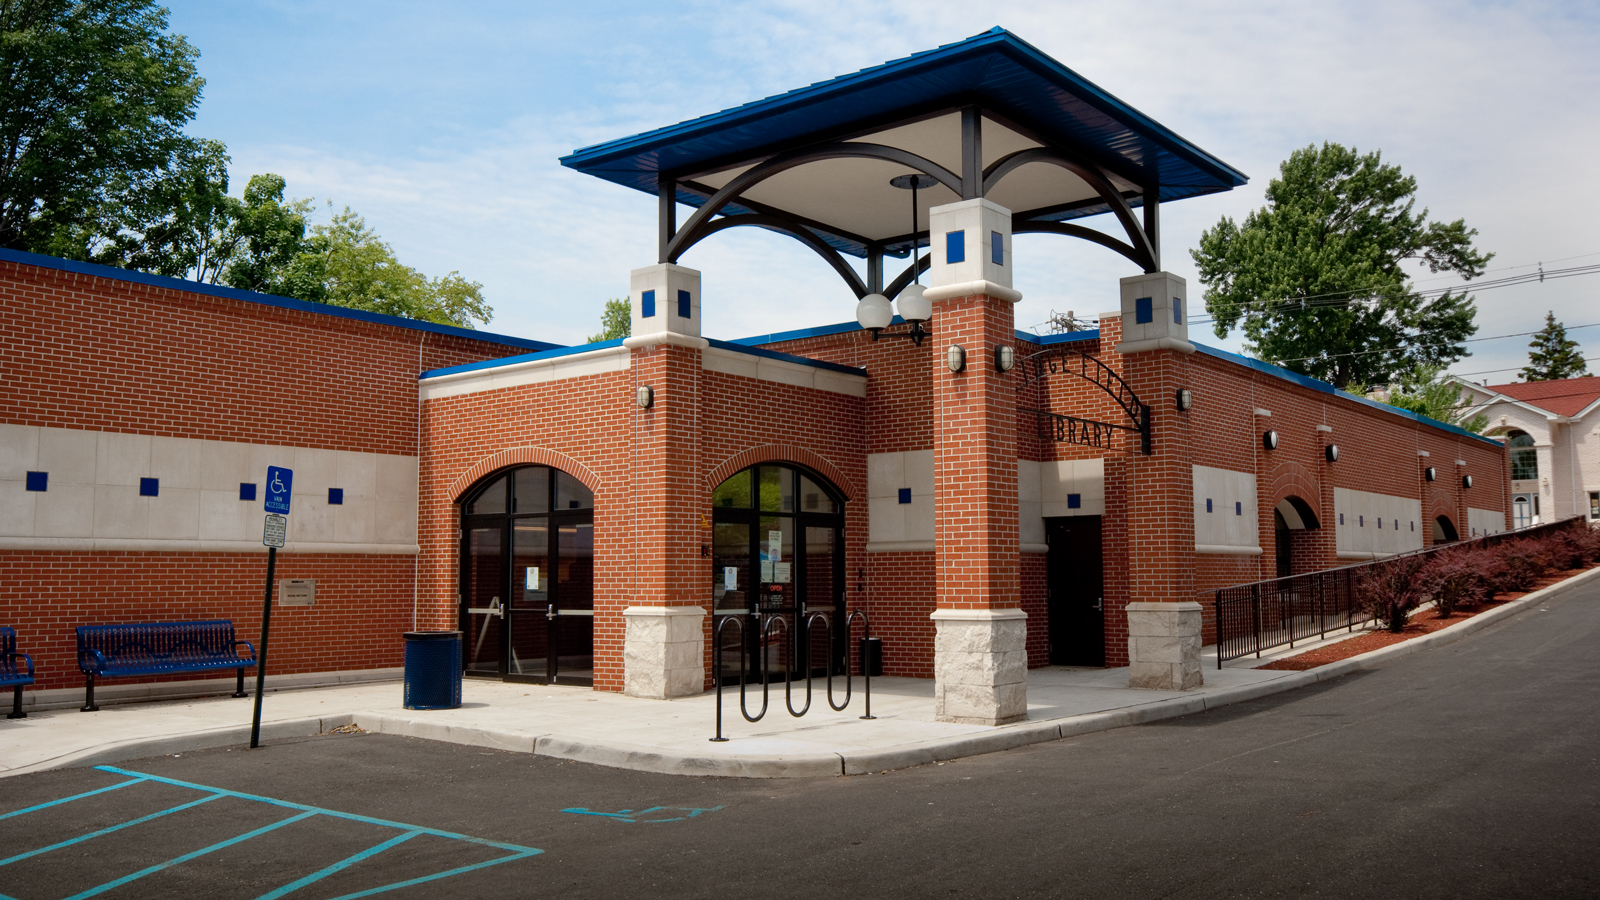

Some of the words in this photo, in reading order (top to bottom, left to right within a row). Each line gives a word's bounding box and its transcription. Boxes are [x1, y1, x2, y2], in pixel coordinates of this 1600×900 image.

[1016, 350, 1139, 418] IDGEFIELD
[1037, 413, 1113, 449] LIBRARY
[266, 501, 289, 510] ACCESSIBLE
